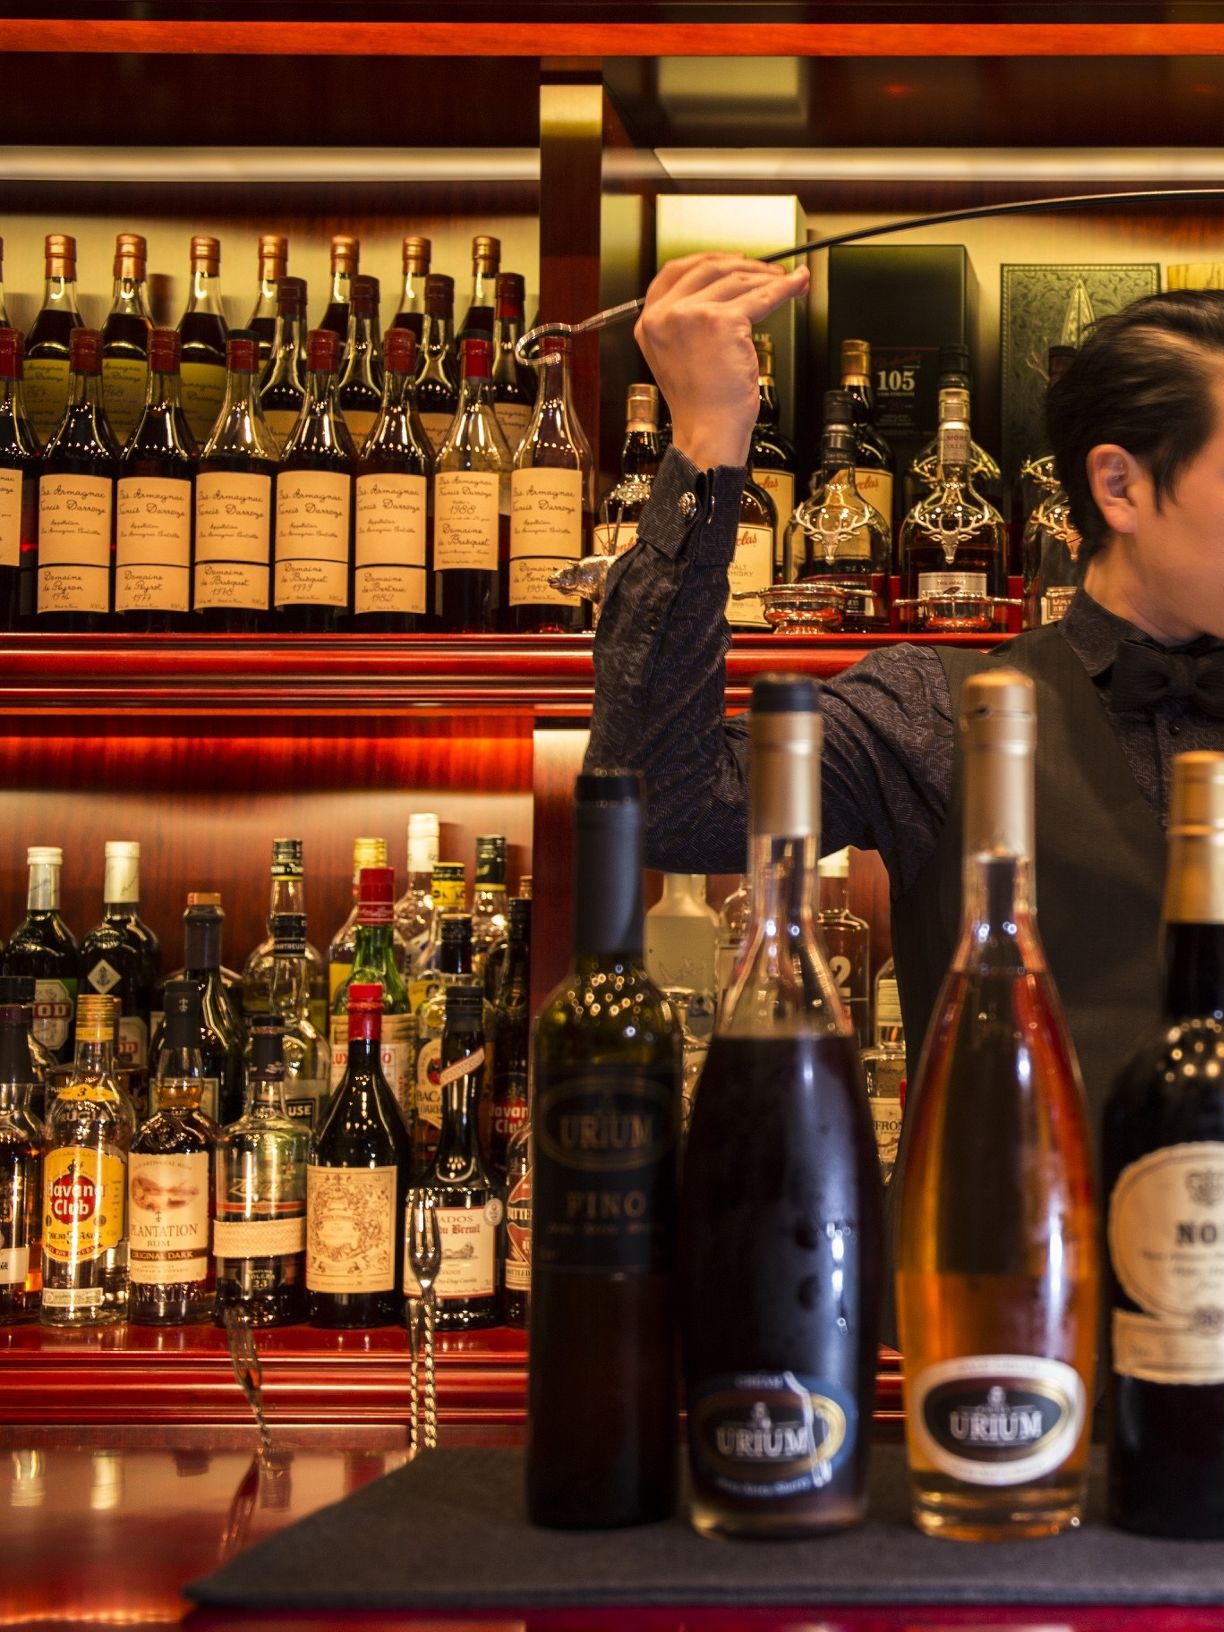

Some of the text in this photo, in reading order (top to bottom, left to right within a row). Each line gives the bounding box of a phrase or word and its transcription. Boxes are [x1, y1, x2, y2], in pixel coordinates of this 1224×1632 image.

[877, 370, 915, 391] 105
[48, 1181, 106, 1198] Havana
[54, 1199, 90, 1216] Club
[950, 1410, 1042, 1441] URIUM
[716, 1426, 809, 1458] URIUM
